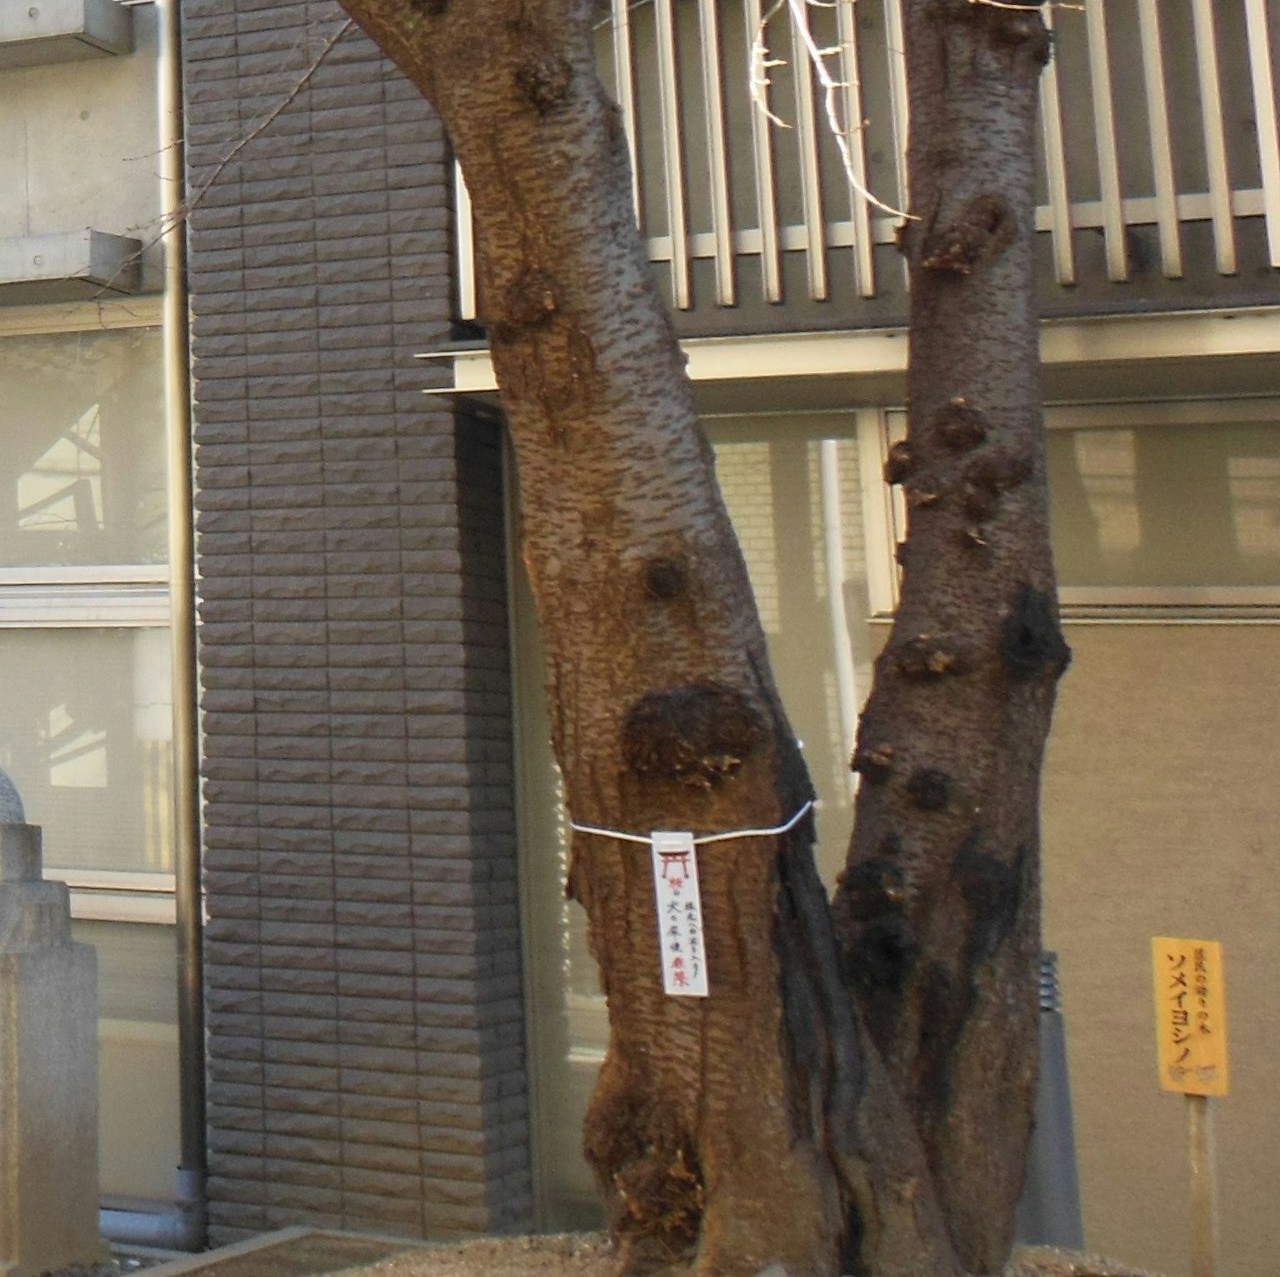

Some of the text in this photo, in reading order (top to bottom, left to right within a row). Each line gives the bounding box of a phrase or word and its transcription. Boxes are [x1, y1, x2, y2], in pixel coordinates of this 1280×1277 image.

[1166, 953, 1192, 1064] ソメイヨシノ
